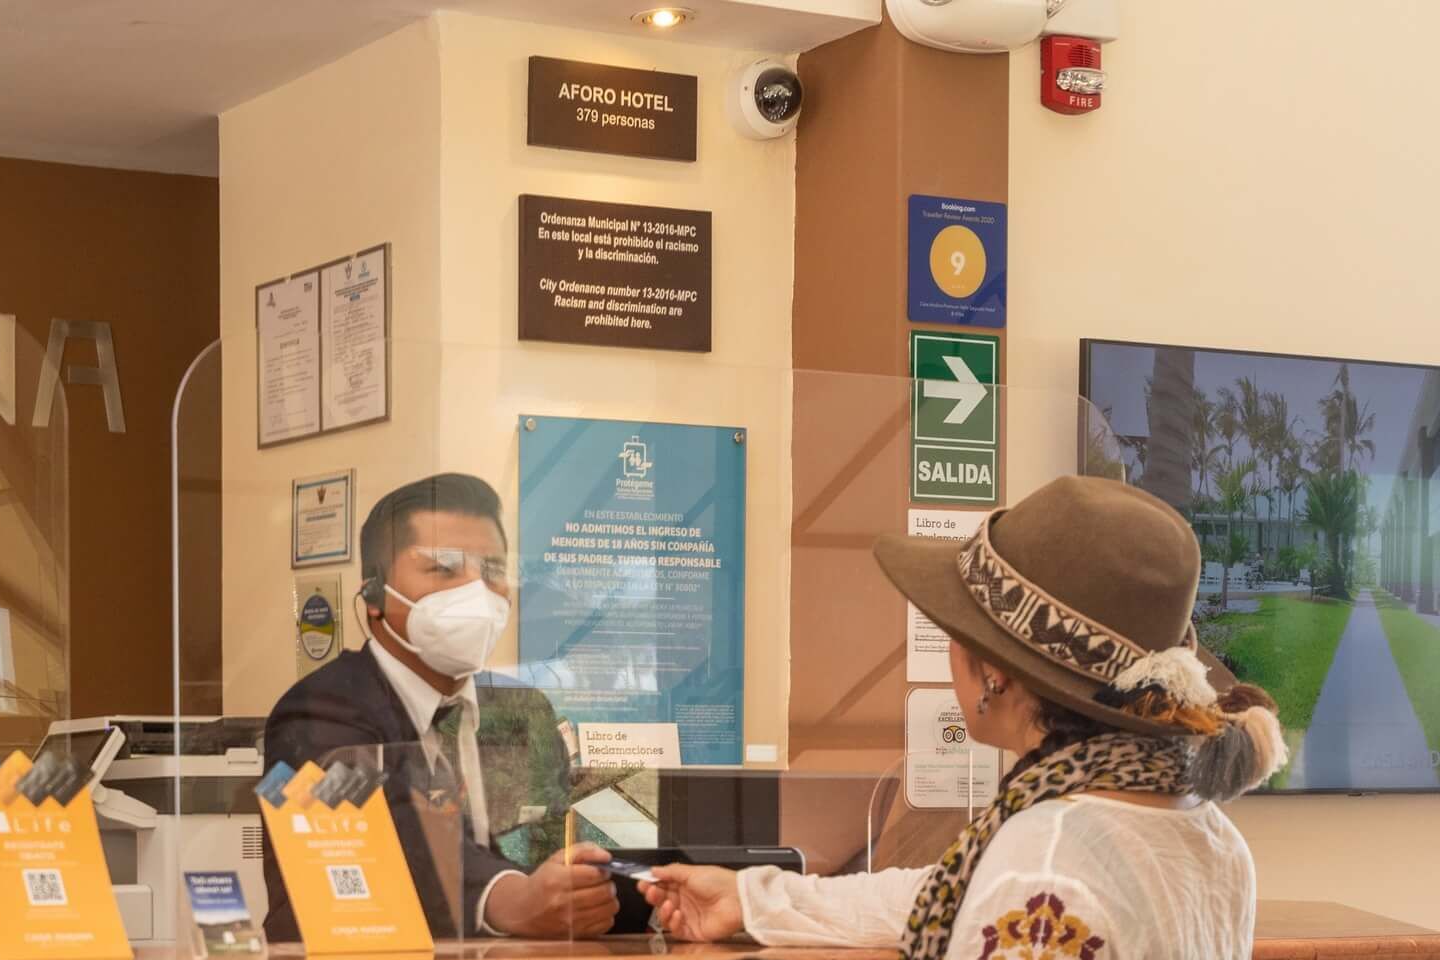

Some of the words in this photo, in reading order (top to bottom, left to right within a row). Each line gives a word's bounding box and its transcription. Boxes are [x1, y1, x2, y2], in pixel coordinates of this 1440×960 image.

[559, 83, 616, 104] AFORO
[621, 90, 674, 112] HOTEL
[1069, 95, 1094, 108] FIRE
[576, 107, 599, 123] 379
[602, 114, 655, 130] personas
[541, 212, 586, 227] Ordenanza
[588, 216, 628, 232] Municipal
[643, 223, 697, 238] 13-2016-MPC
[538, 227, 550, 239] En
[552, 230, 569, 241] este
[571, 230, 592, 243] local
[594, 232, 611, 244] está
[613, 234, 654, 249] prohibido
[656, 238, 663, 249] el
[665, 239, 699, 252] racismo
[578, 249, 584, 260] y
[586, 247, 593, 259] la
[595, 248, 659, 264] discriminación.
[950, 251, 965, 276] 9
[539, 278, 557, 293] City
[559, 279, 606, 296] Ordenance
[607, 284, 641, 298] number
[642, 287, 698, 302] 13-2016-MPC
[554, 295, 587, 309] Racism
[588, 297, 605, 310] and
[606, 298, 667, 314] discrimination
[668, 306, 683, 316] are
[585, 313, 629, 328] prohibited
[630, 315, 652, 329] here.
[918, 460, 992, 485] SALIDA
[584, 509, 595, 519] EN
[596, 510, 615, 520] ESTE
[916, 517, 942, 529] Libro
[944, 519, 957, 529] de
[566, 522, 580, 533] NO
[581, 523, 635, 535] ADMITIMOS
[636, 525, 646, 536] EL
[648, 525, 688, 537] INGRESO
[689, 527, 701, 538] DE
[552, 536, 597, 548] MENORES
[598, 538, 610, 549] DE
[611, 539, 622, 549] 18
[624, 537, 649, 551] AÑOS
[650, 540, 666, 551] SIN
[667, 540, 715, 553] COMPAÑÍA
[544, 552, 557, 563] DE
[558, 552, 577, 563] SUS
[617, 555, 649, 566] TUTOR
[649, 556, 656, 566] O
[657, 556, 721, 569] RESPONSABLE
[586, 731, 613, 741] Libro
[615, 731, 627, 741] de
[587, 744, 665, 756] Reclamaciones
[589, 759, 619, 768] Claim
